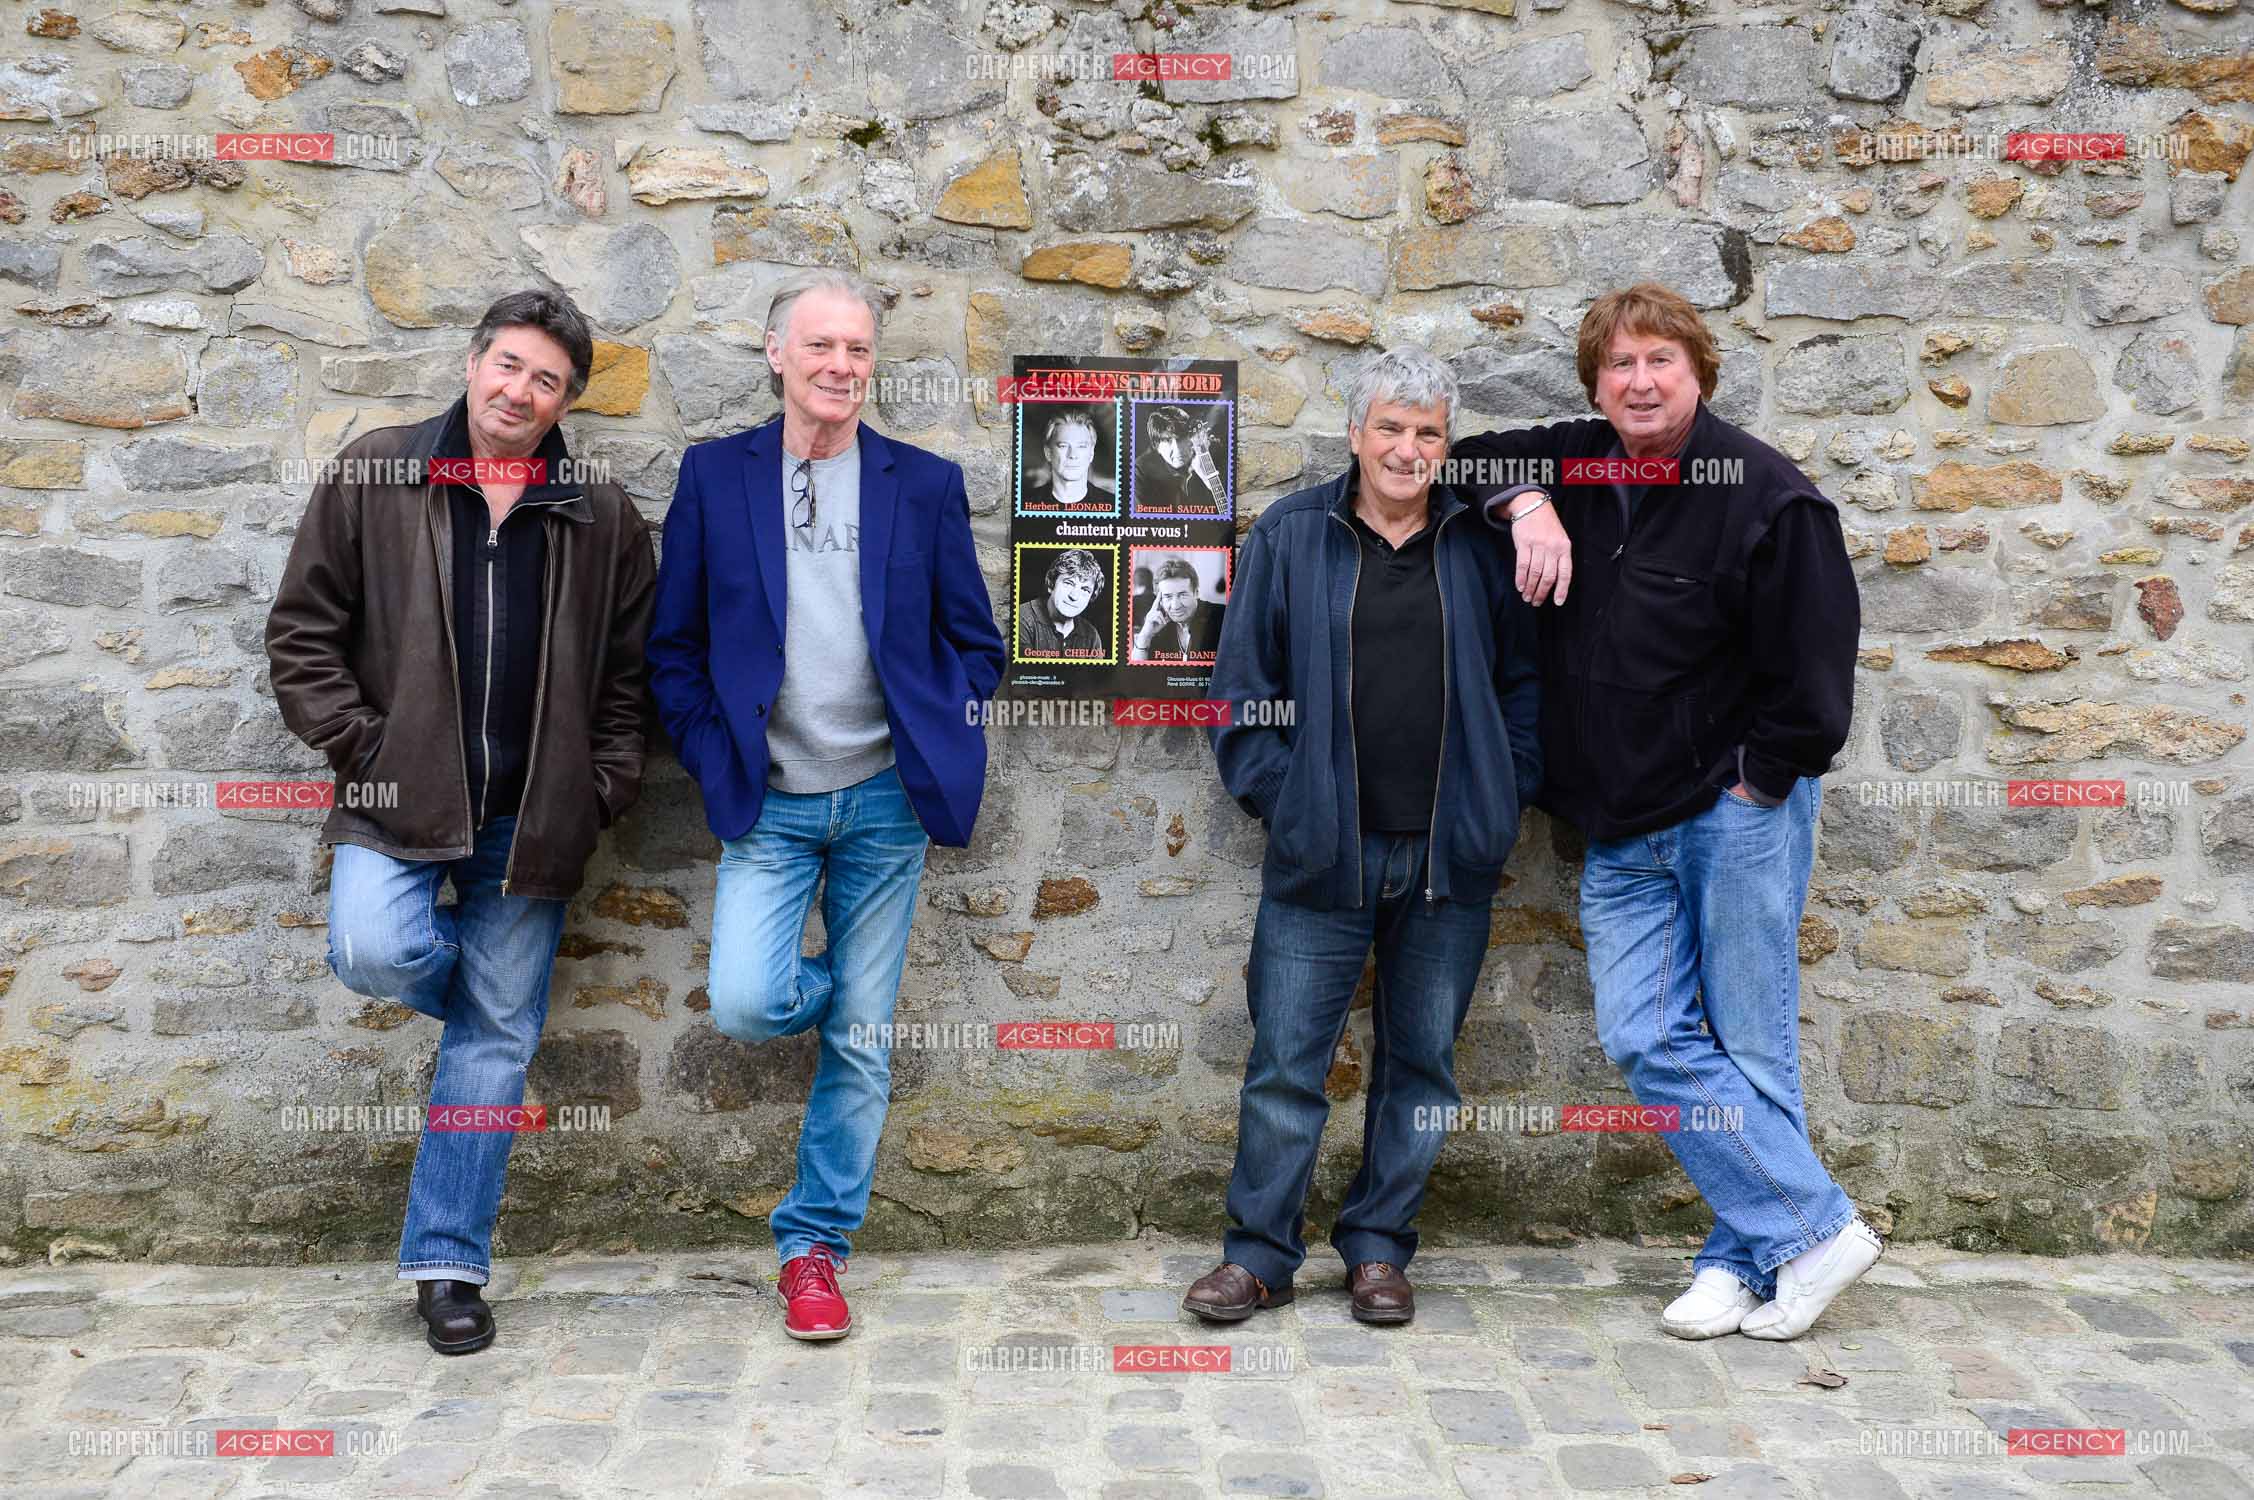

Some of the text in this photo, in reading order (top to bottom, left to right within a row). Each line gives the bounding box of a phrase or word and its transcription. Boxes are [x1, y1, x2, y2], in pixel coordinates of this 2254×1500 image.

[1024, 502, 1112, 512] Herbert LEONARD
[1136, 504, 1217, 514] Bernard SAUVAT
[1056, 521, 1114, 537] chantent
[1116, 525, 1149, 540] pour
[1150, 527, 1181, 538] vous
[1024, 648, 1106, 658] Georges CHELON
[1154, 650, 1183, 660] Pascal
